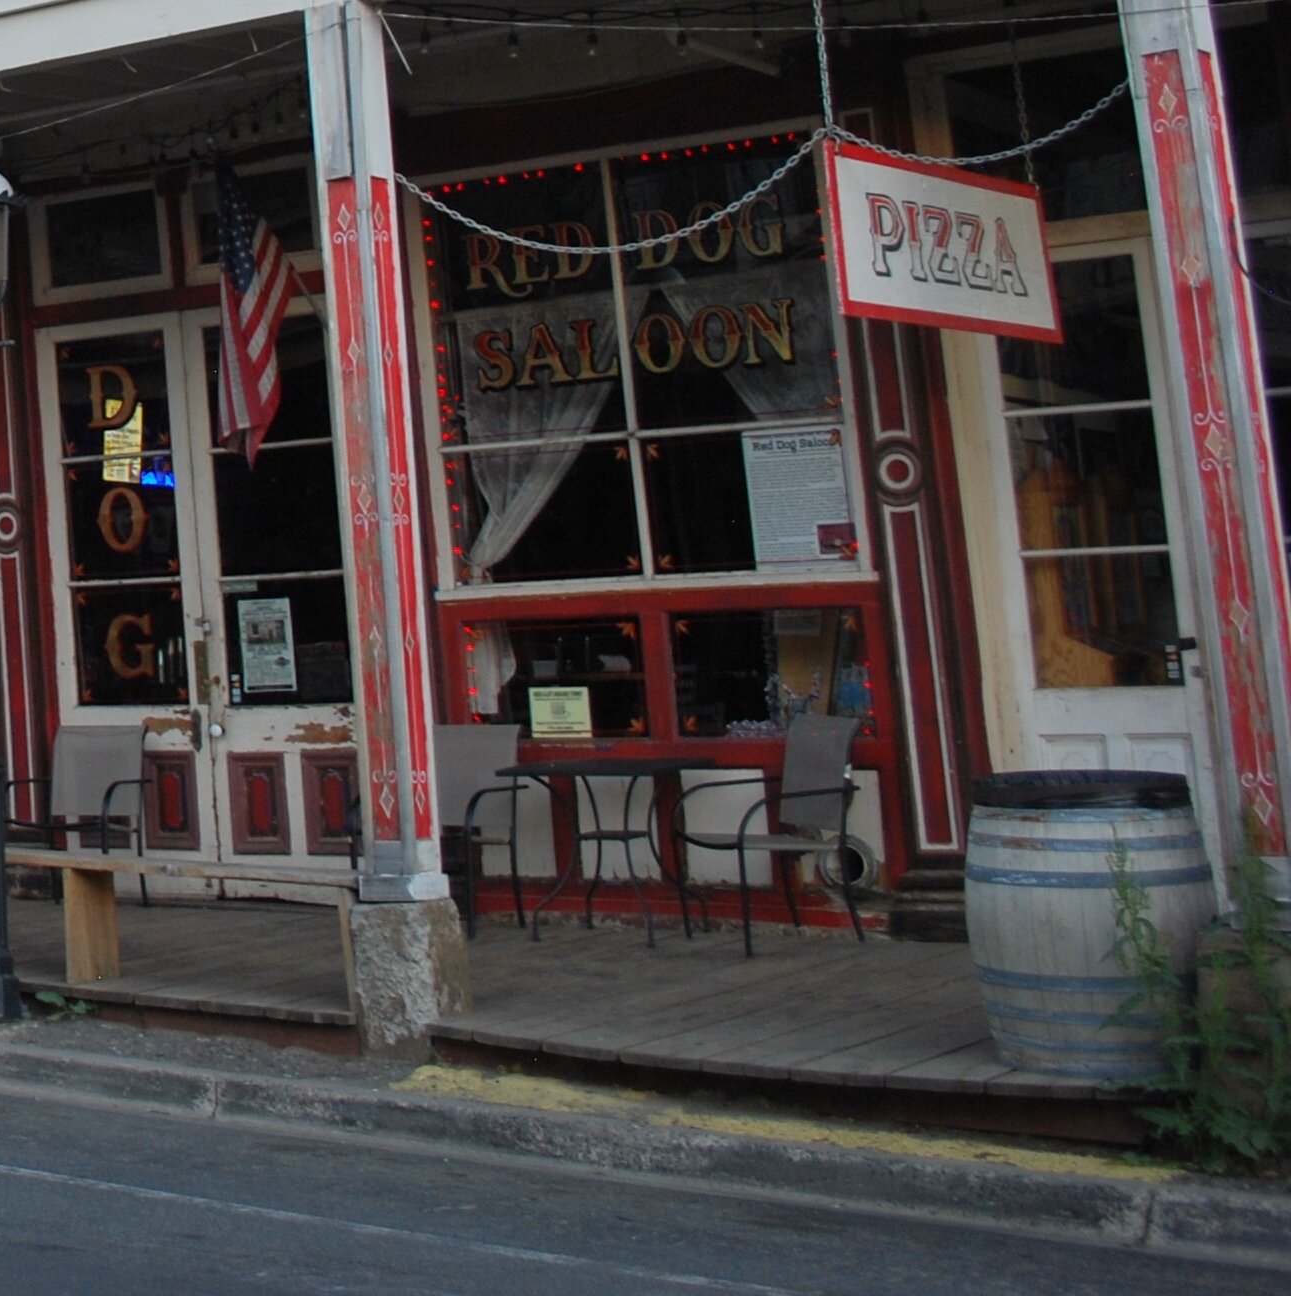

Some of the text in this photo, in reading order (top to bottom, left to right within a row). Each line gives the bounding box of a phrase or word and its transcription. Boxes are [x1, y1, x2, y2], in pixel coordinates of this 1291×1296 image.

[463, 191, 787, 300] RED DOG
[865, 191, 1030, 299] PIZZA
[475, 296, 798, 393] SALOON
[751, 436, 833, 453] Red Dog Saloo
[84, 364, 159, 679] DOG
